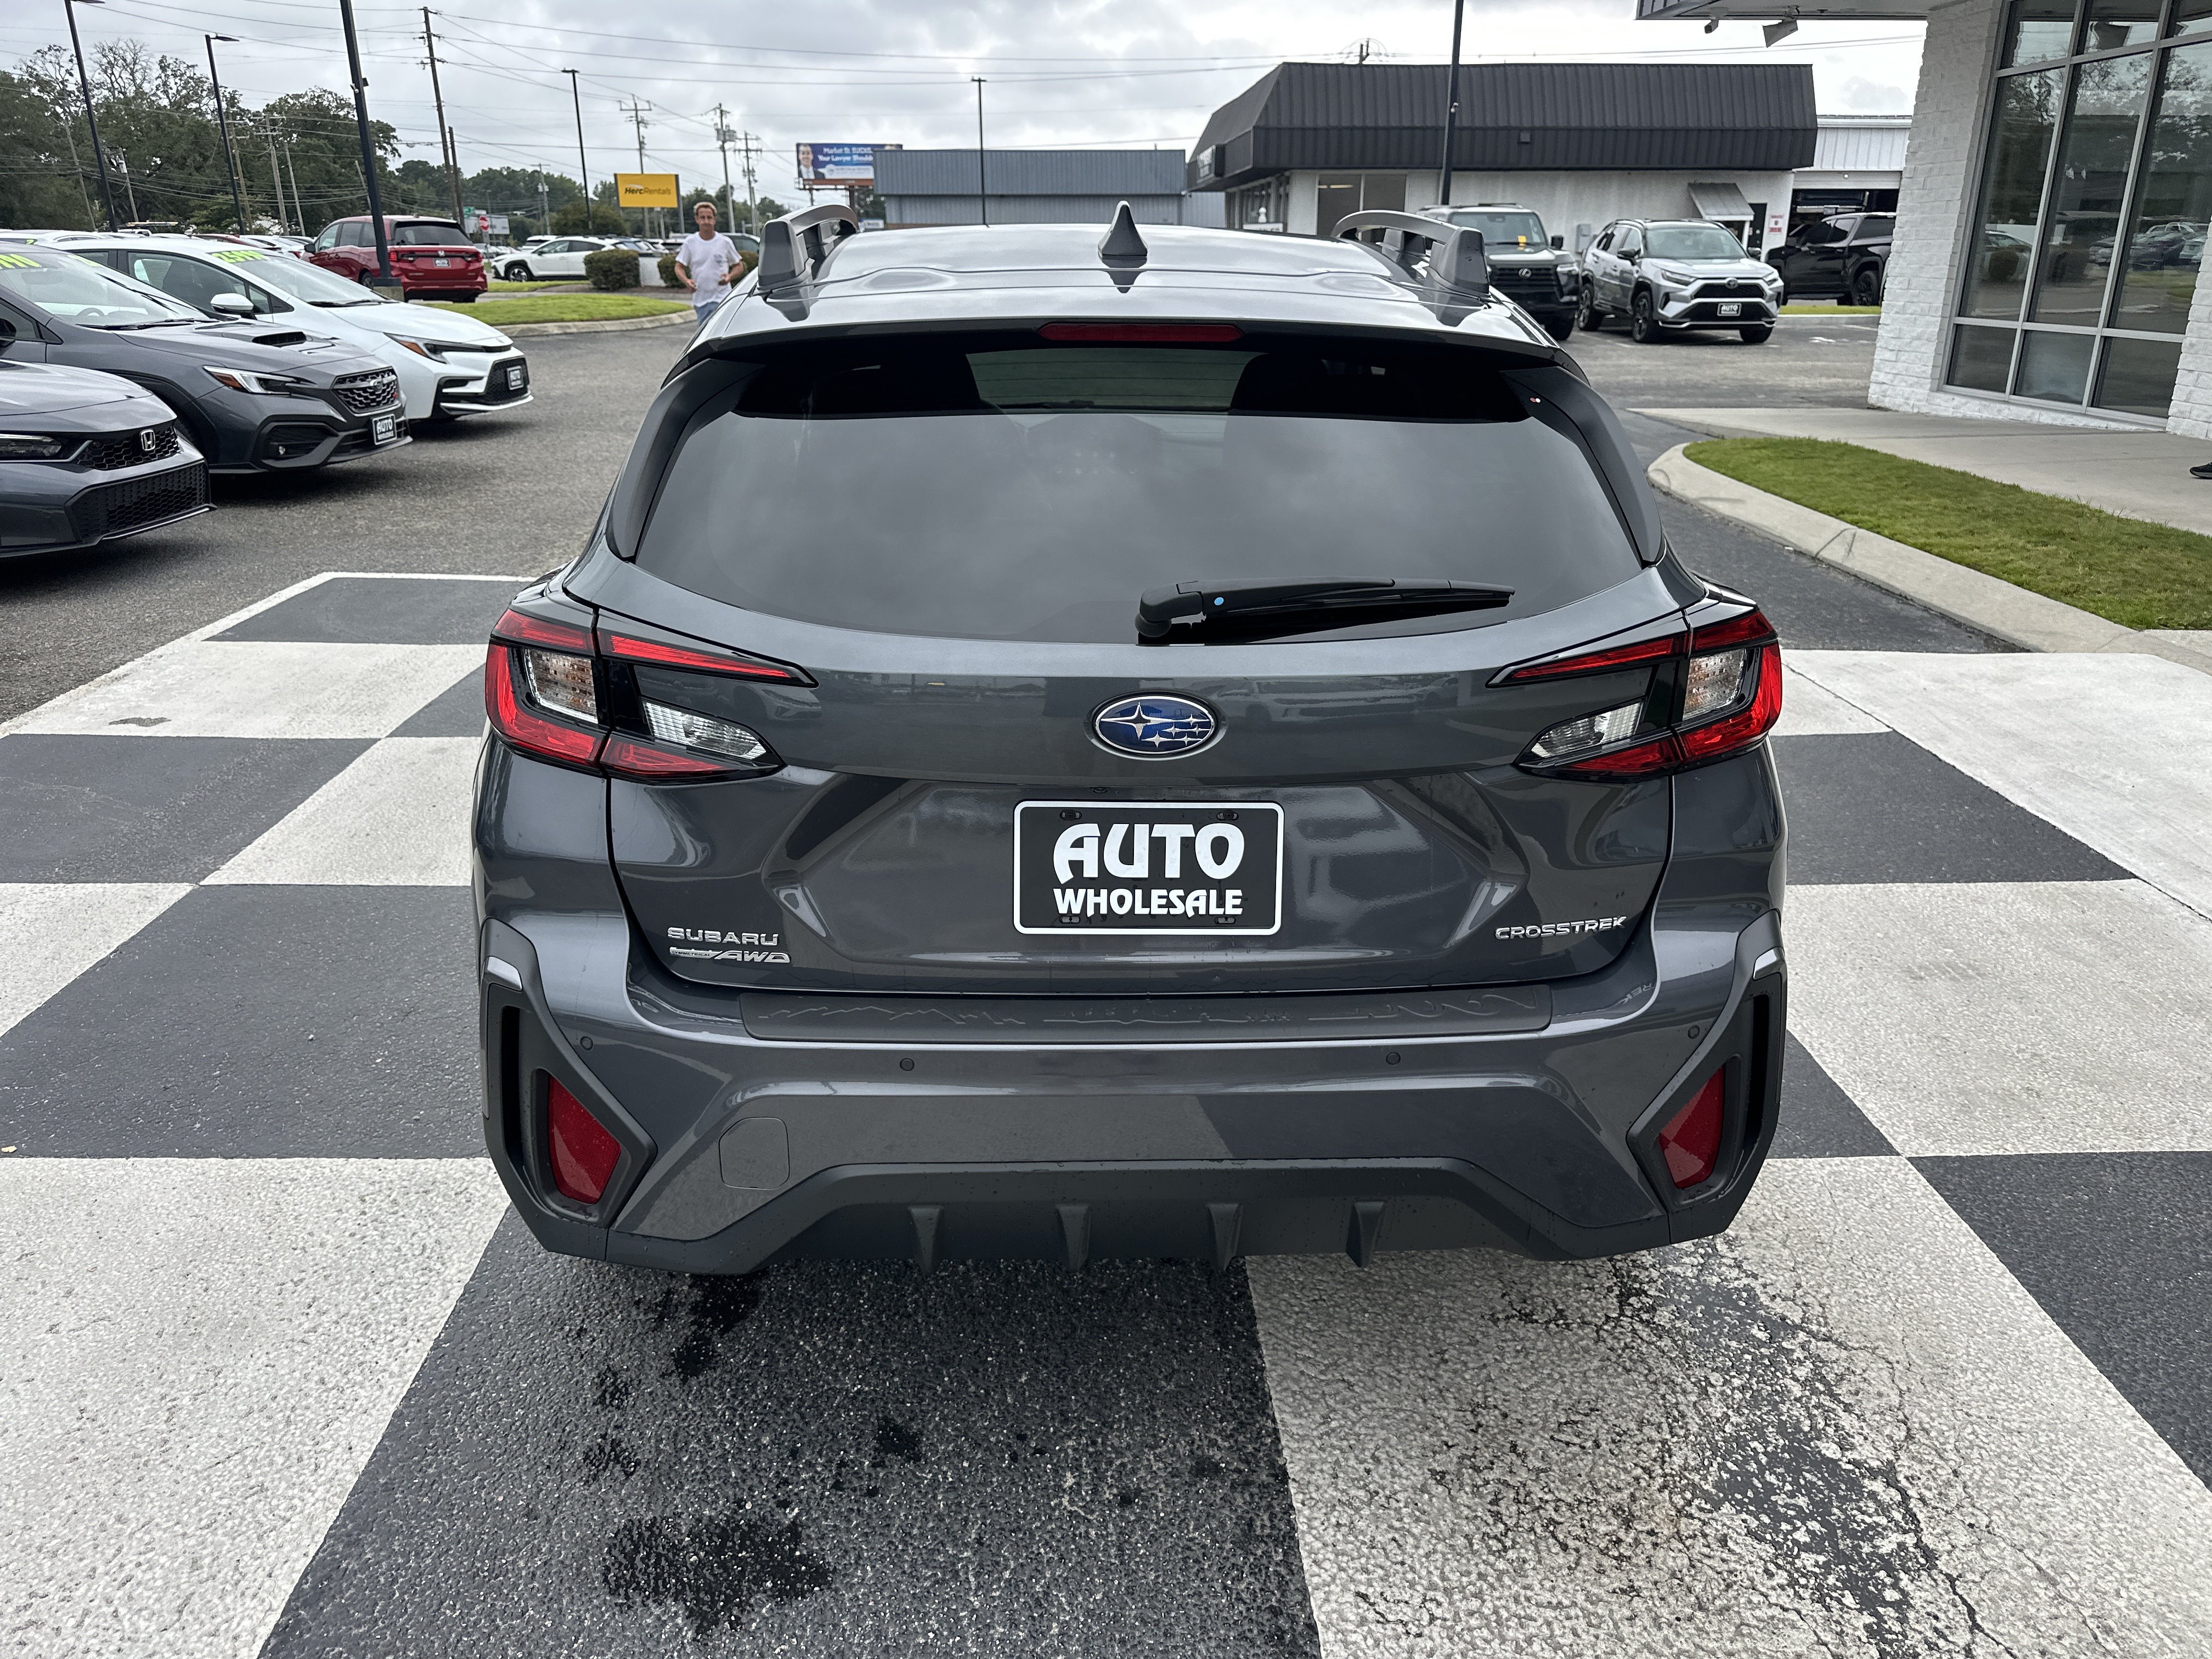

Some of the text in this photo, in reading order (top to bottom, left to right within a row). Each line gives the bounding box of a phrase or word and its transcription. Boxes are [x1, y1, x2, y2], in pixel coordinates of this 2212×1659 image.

[1053, 823, 1245, 884] AUTO
[1053, 888, 1243, 918] WHOLESALE
[667, 927, 779, 946] SUBARU
[1494, 915, 1627, 940] CROSSTREK
[714, 950, 791, 963] AWD
